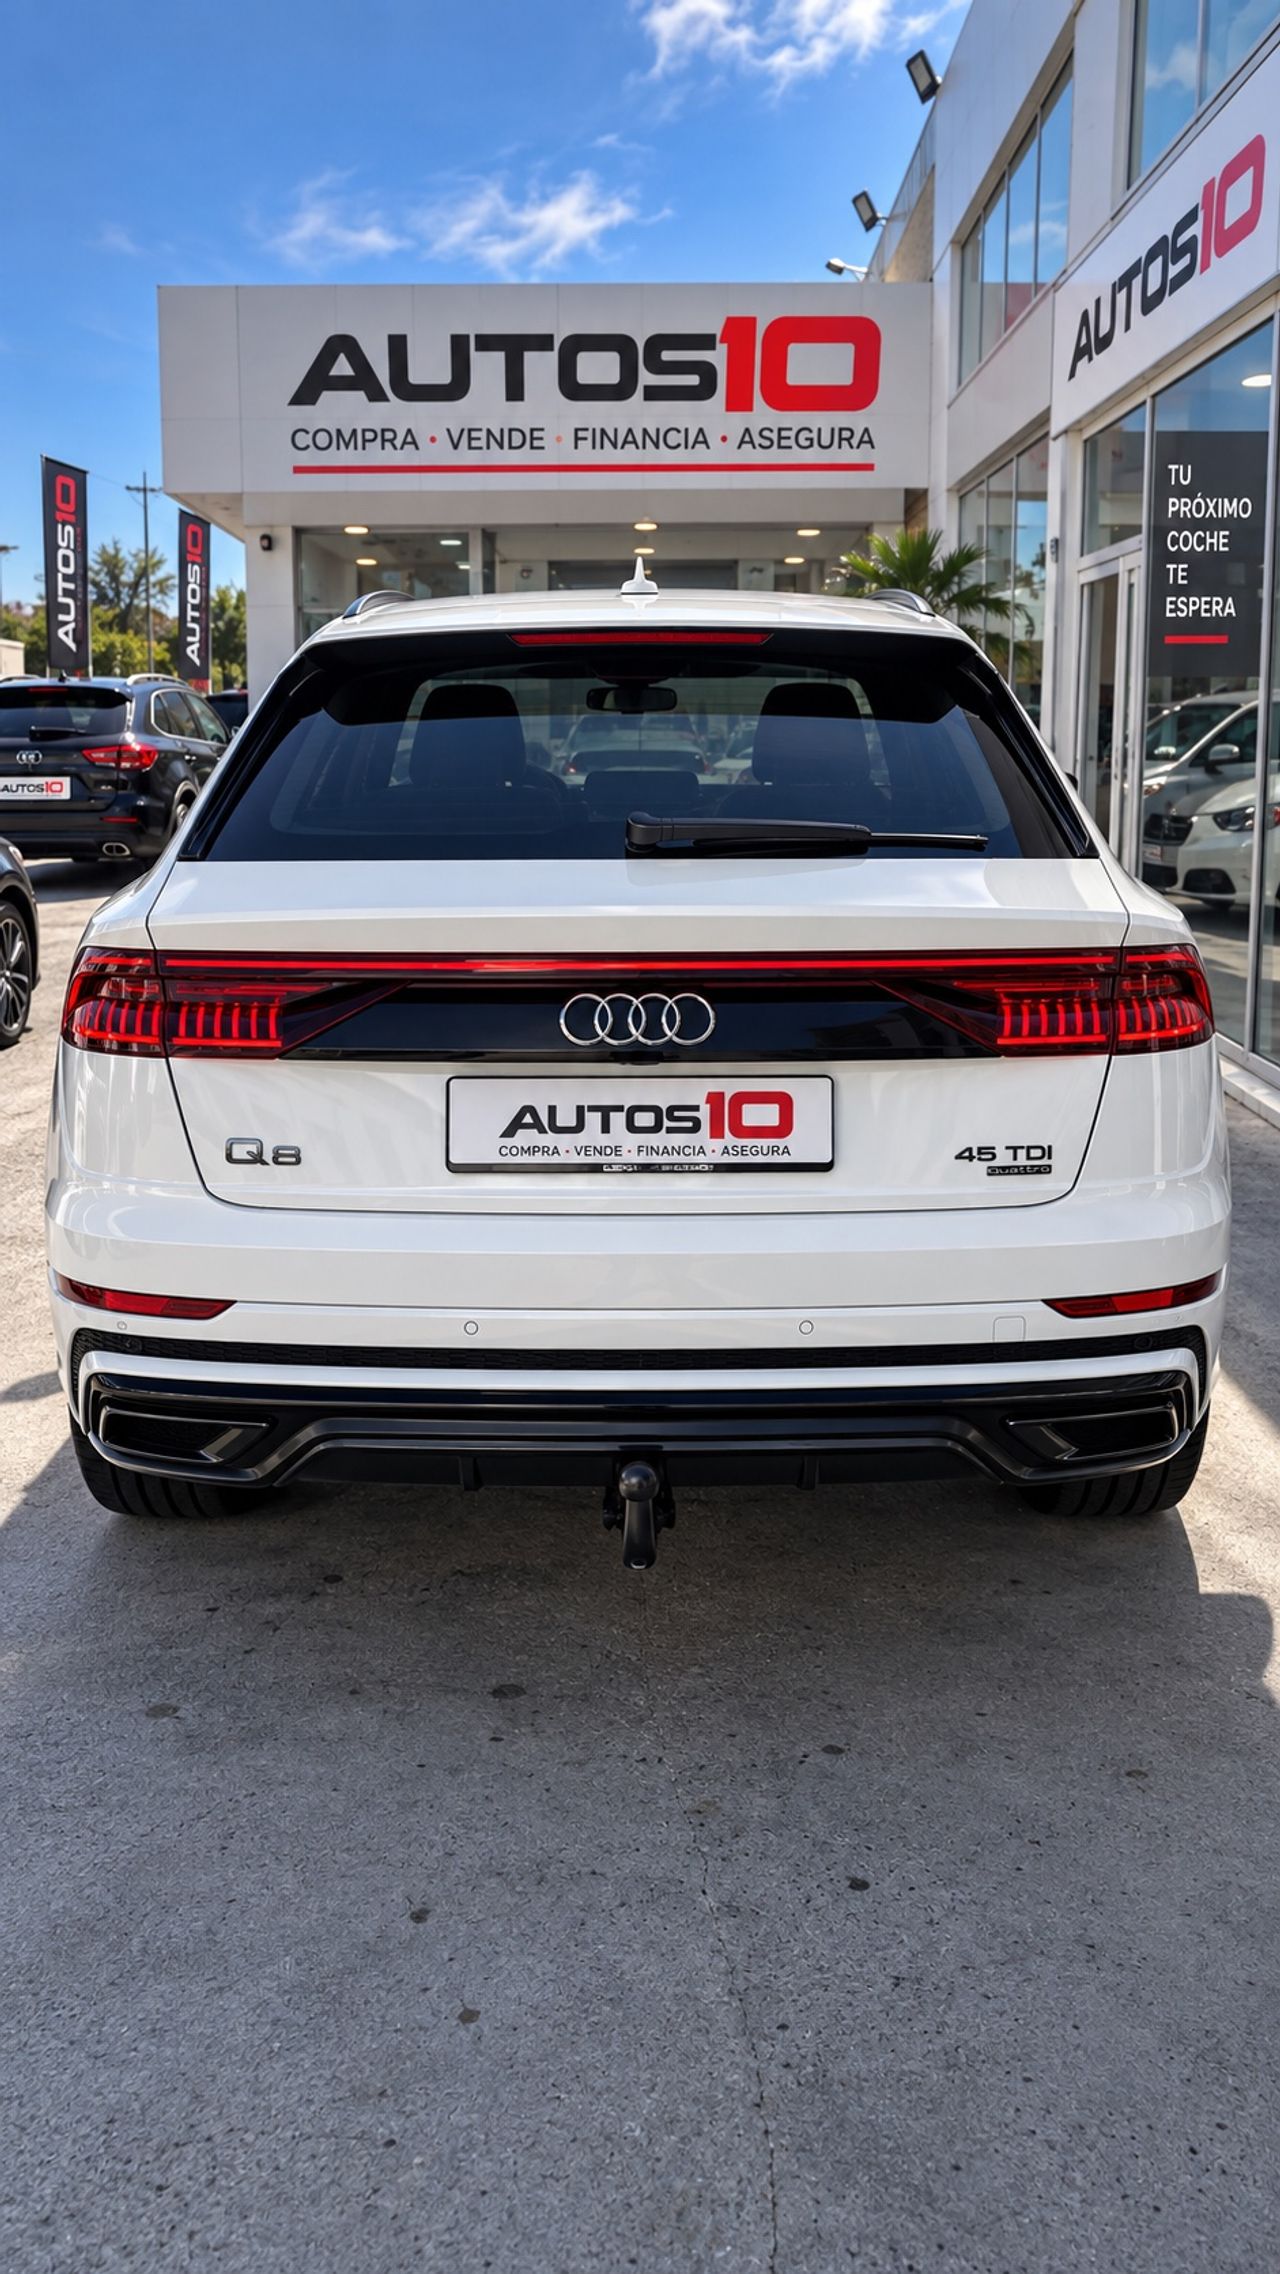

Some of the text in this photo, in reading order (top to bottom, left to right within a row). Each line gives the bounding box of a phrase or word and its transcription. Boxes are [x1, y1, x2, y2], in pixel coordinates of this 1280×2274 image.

[1068, 134, 1266, 382] AUTOS10
[288, 316, 881, 412] AUTOS10
[290, 426, 876, 452] COMPRA VENDE FINANCIA ASEGURA
[1167, 464, 1192, 486] TU
[1167, 492, 1252, 519] PRÓXIMO
[1166, 530, 1230, 552] COCHE
[55, 474, 77, 652] AUTOS10
[1166, 564, 1189, 585] TE
[186, 523, 203, 667] AUTOS10
[1165, 596, 1236, 618] ESPERA
[0, 781, 63, 794] AUTOS10
[499, 1091, 794, 1139] AUTOS10
[225, 1137, 301, 1166] Q8
[499, 1144, 792, 1157] COMPRA VENDE FINANCIA ASEGURA
[954, 1144, 1053, 1162] 45 TDI
